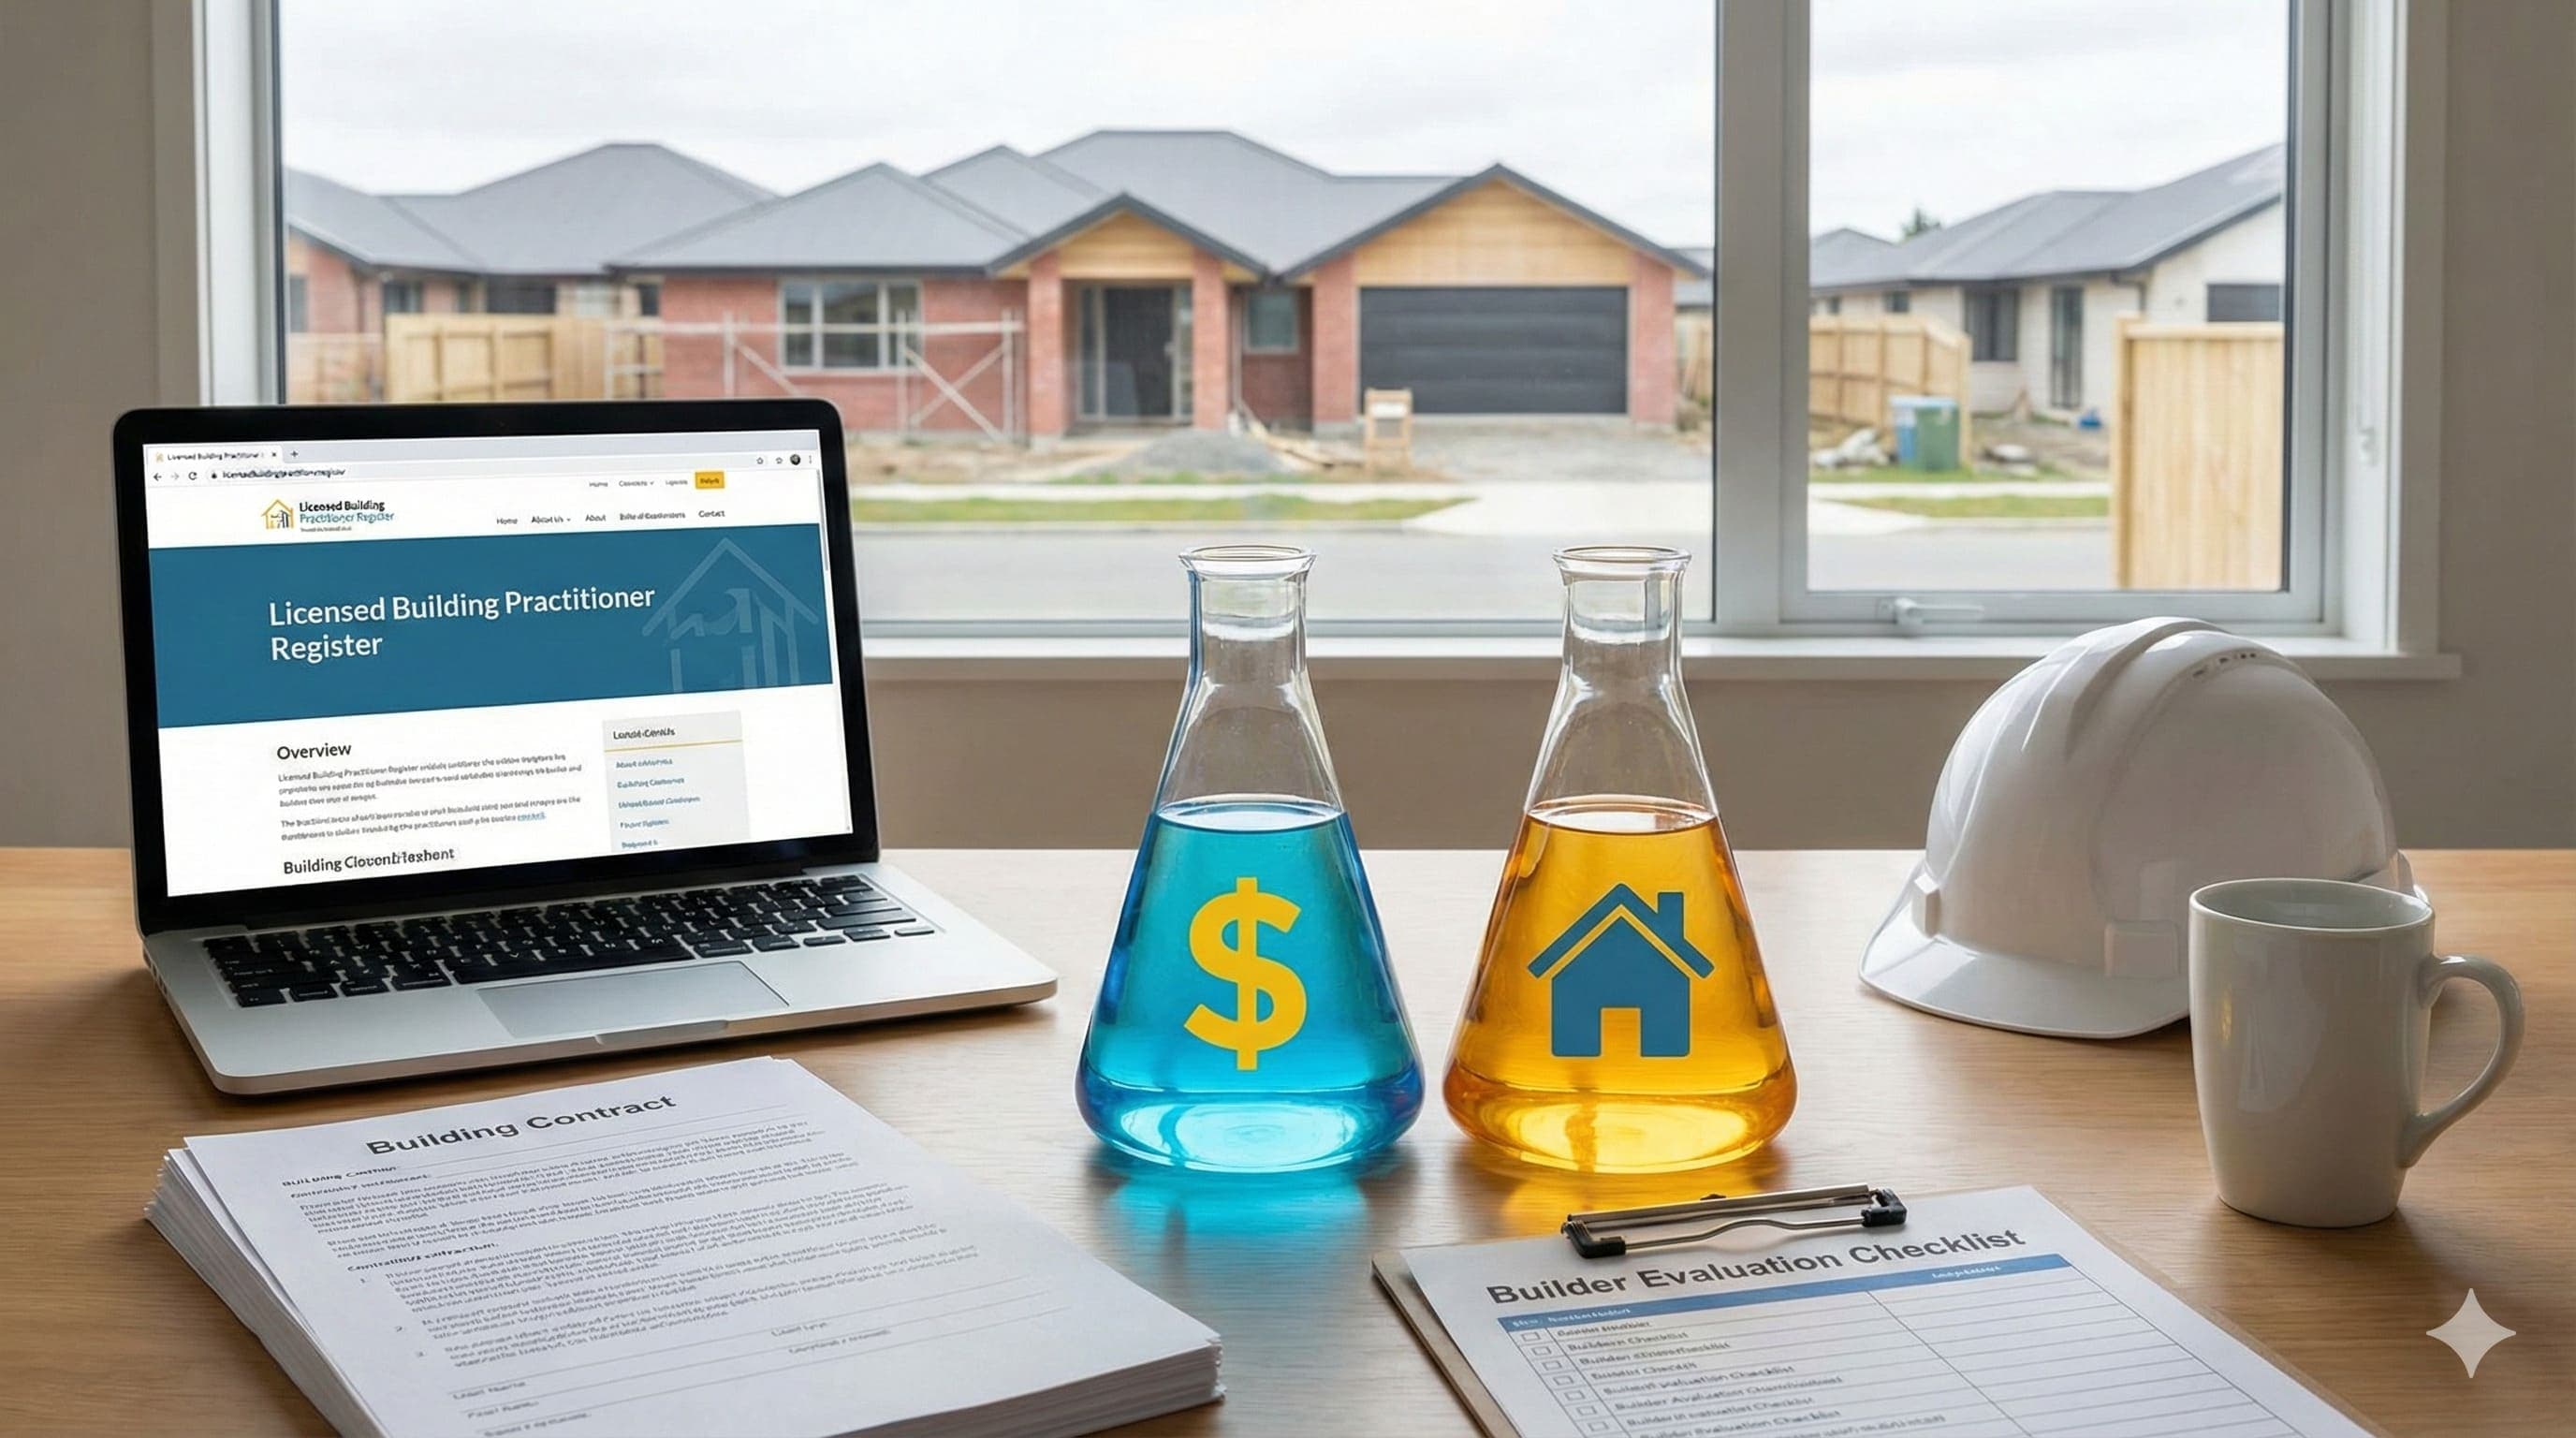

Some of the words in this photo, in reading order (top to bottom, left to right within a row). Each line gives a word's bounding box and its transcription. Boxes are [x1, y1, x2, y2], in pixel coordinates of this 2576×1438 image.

[270, 596, 386, 626] Licensed
[392, 593, 500, 620] Building
[505, 586, 655, 614] Practitioner
[271, 634, 383, 664] Register
[276, 742, 352, 760] Overview
[284, 858, 343, 874] Building
[366, 1123, 520, 1155] Building
[525, 1093, 677, 1130] Contract
[1486, 1277, 1627, 1304] Builder
[1636, 1253, 1843, 1289] Evaluation
[1849, 1229, 2026, 1264] Checklist
